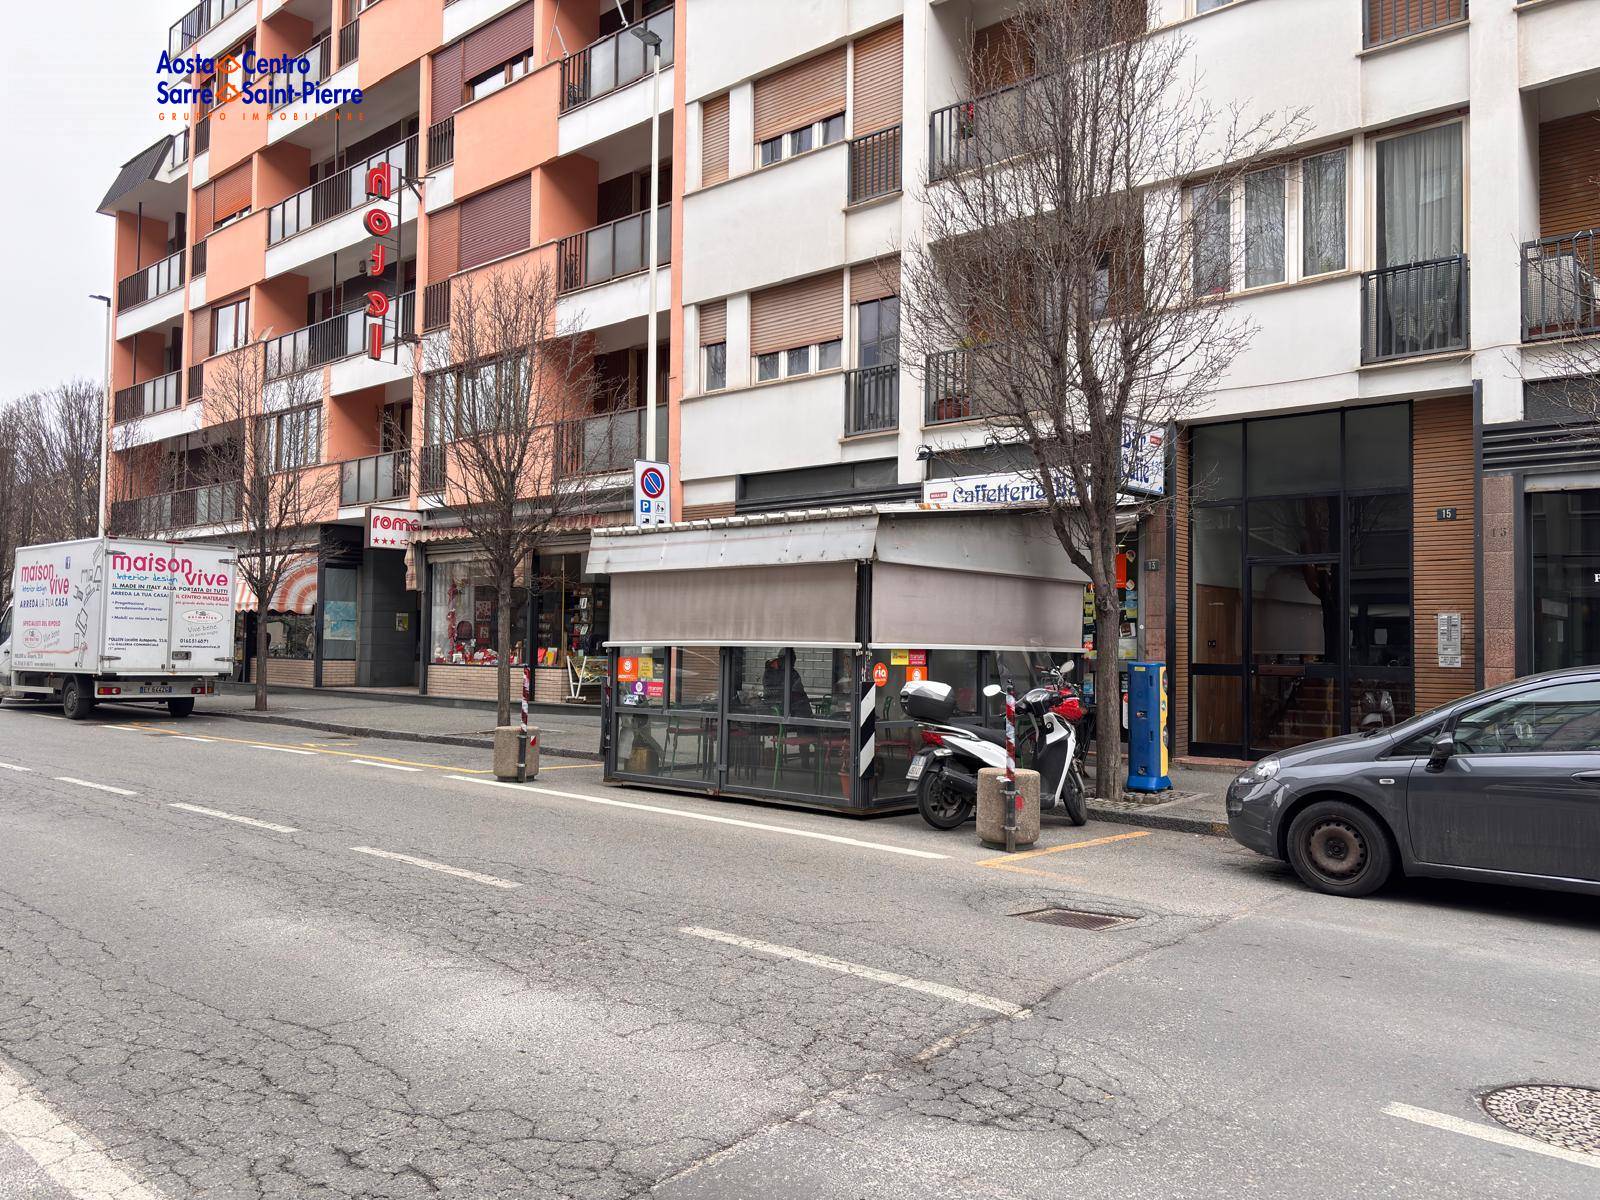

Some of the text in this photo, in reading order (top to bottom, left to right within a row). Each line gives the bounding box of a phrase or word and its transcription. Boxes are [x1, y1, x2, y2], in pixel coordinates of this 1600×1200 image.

[952, 480, 1046, 503] Caffetteria
[1442, 509, 1452, 518] 15
[372, 515, 421, 532] roma
[112, 552, 193, 573] maison
[1148, 561, 1156, 570] 13
[21, 561, 54, 583] maison
[152, 573, 178, 584] design
[184, 569, 229, 586] vive
[49, 574, 70, 595] vive
[20, 599, 39, 608] ARREDA
[54, 598, 69, 607] CASA
[874, 665, 887, 678] ria
